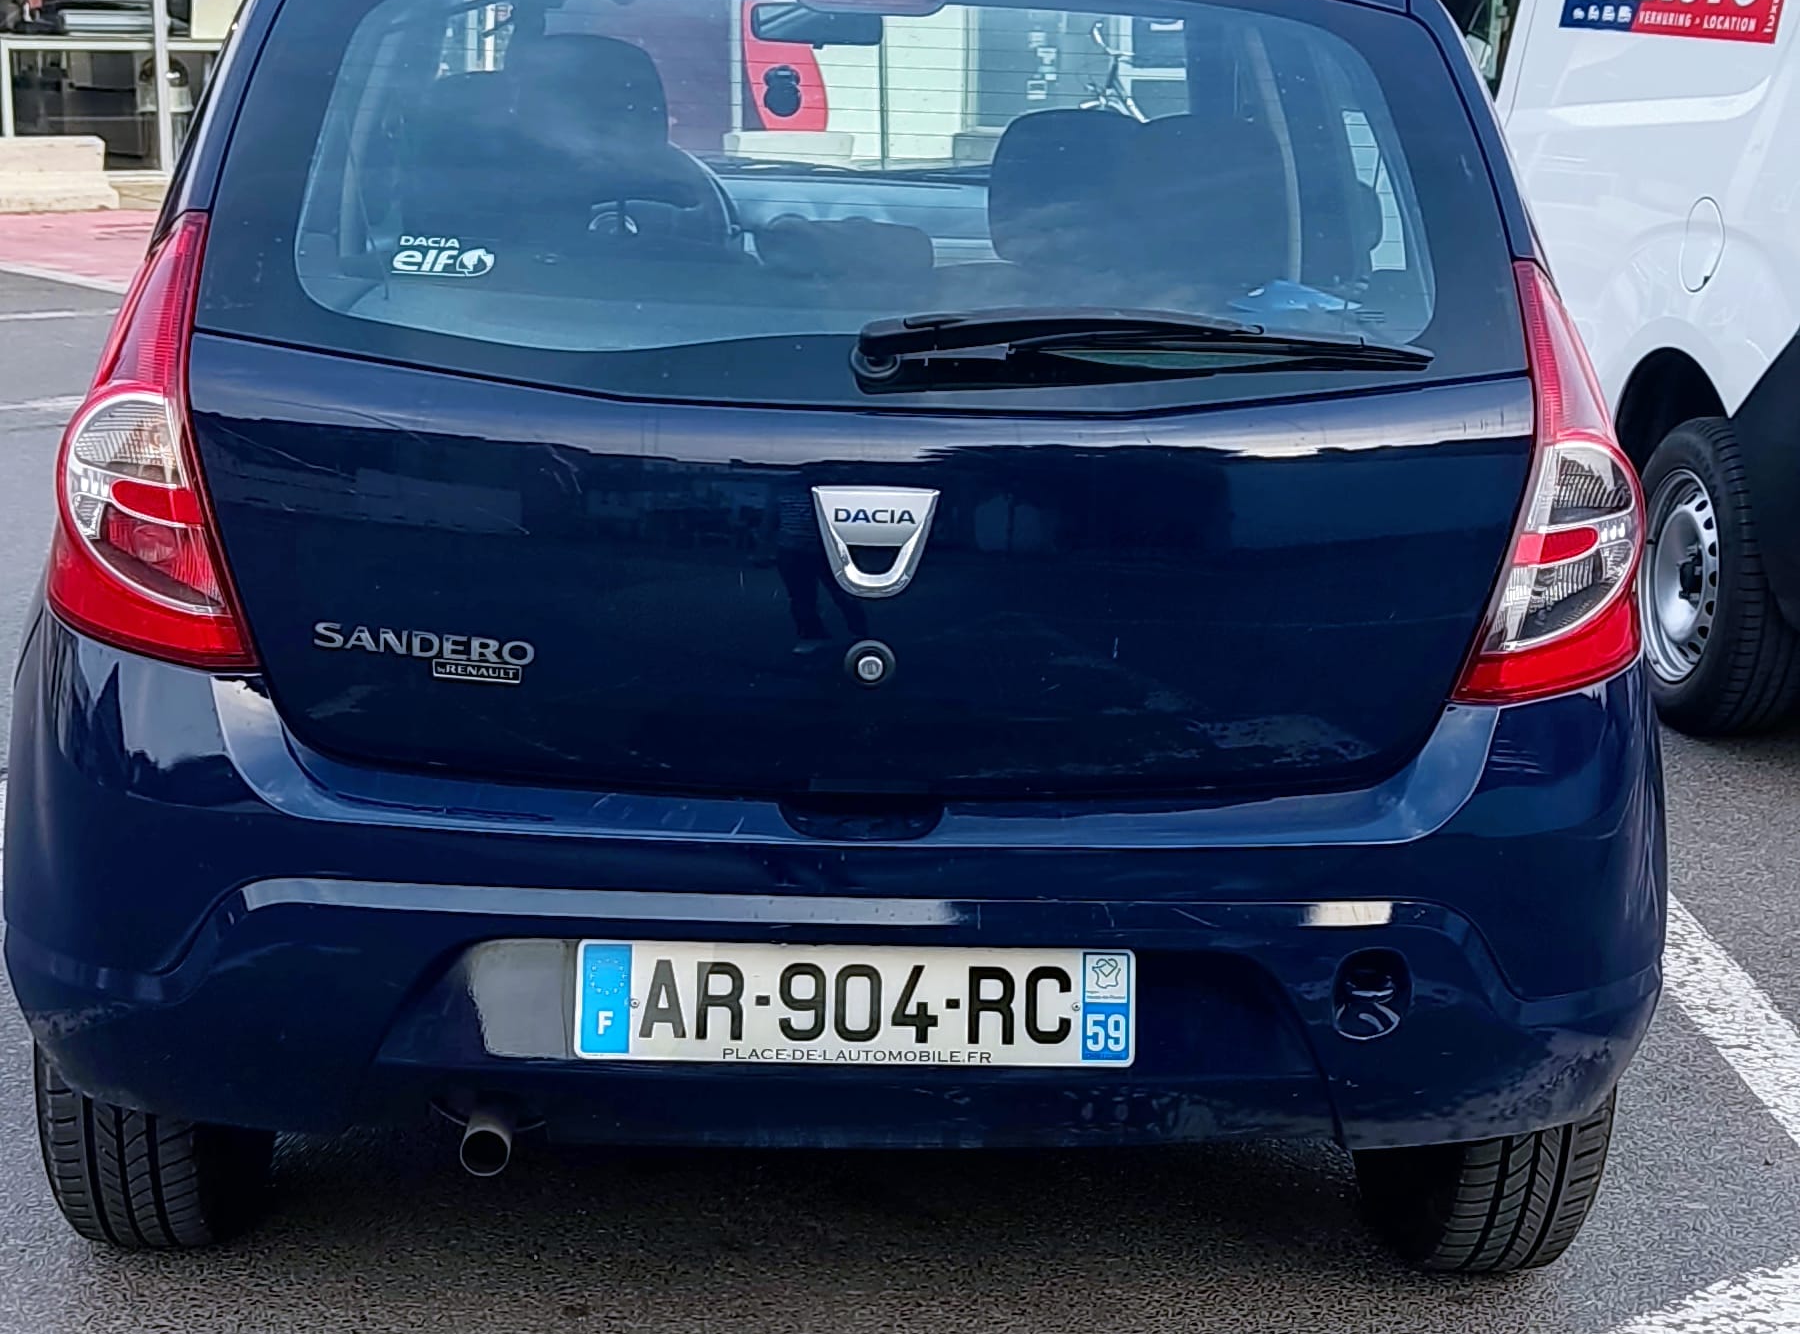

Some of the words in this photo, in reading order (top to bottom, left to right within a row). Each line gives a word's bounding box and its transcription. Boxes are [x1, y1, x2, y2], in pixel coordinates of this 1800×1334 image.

[1639, 10, 1692, 28] VERHURING
[1703, 15, 1757, 33] LOCATION
[400, 235, 460, 248] DACIA
[392, 249, 459, 272] elf
[834, 507, 916, 525] DACIA
[313, 621, 535, 666] SANDERO
[446, 664, 516, 679] RENAULT
[638, 958, 1072, 1046] AR-904-RC
[598, 1010, 614, 1035] F
[1086, 1013, 1126, 1052] 59
